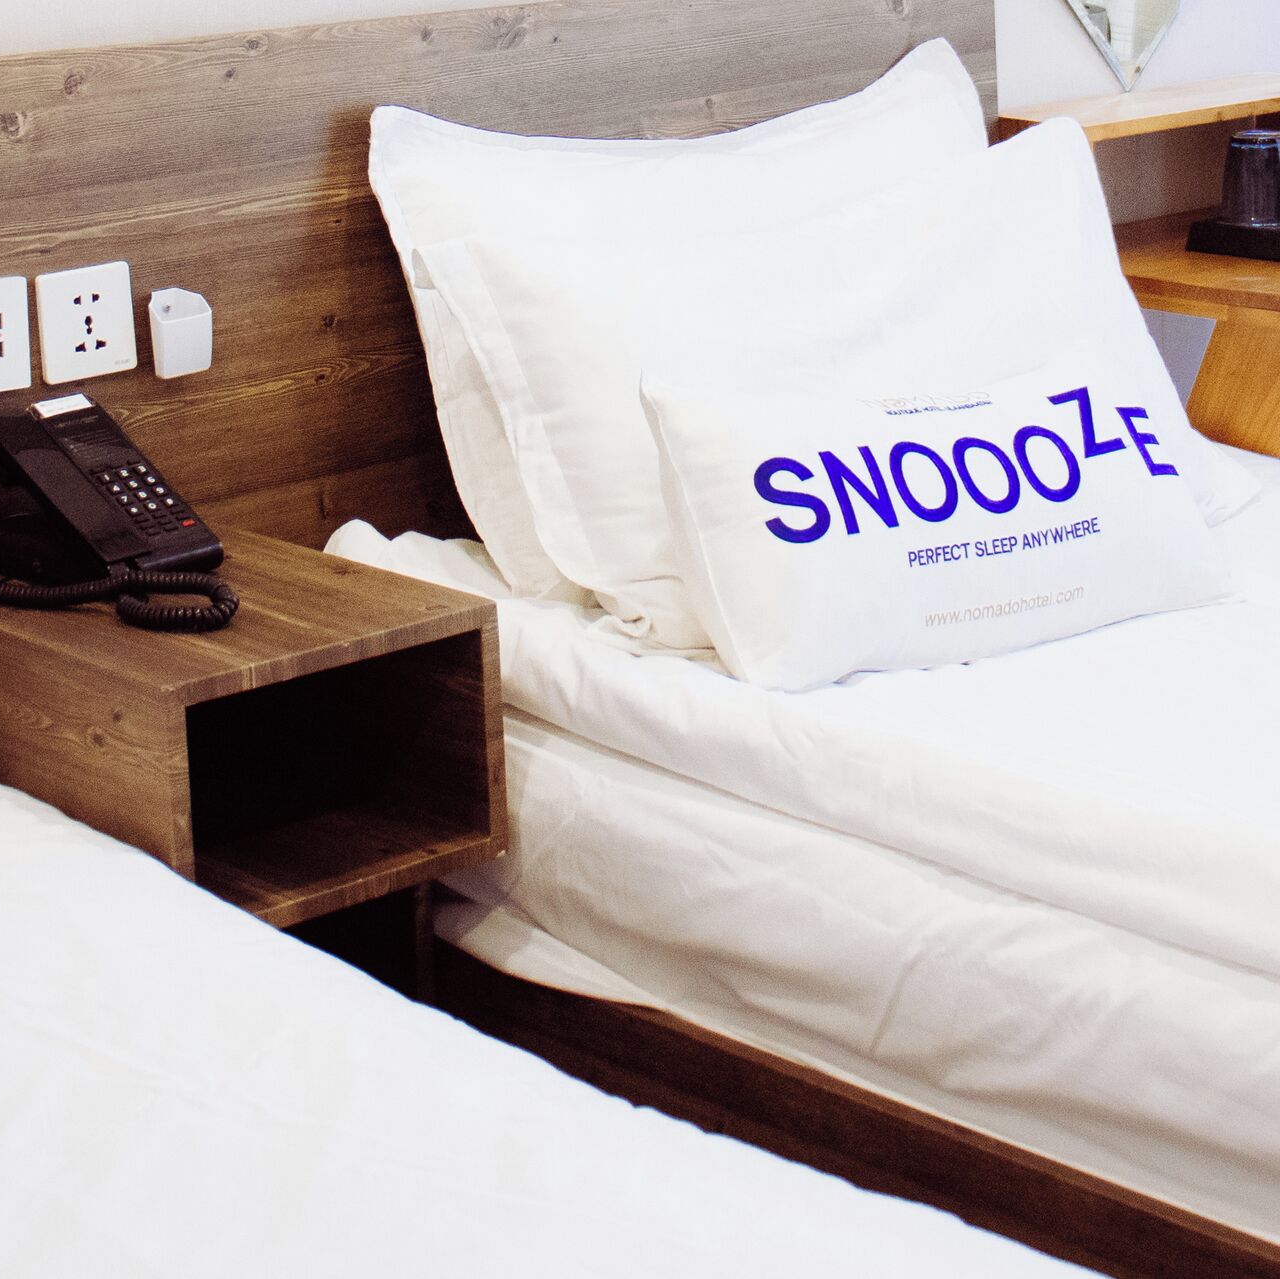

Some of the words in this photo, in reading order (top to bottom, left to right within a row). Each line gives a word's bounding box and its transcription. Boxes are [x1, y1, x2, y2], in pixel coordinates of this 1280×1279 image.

[753, 386, 1180, 544] SNOOOZE
[908, 542, 970, 568] PERFECT
[974, 536, 1018, 558] SLEEP
[1022, 517, 1101, 551] ANYWHERE
[924, 585, 1085, 627] www.nomadohotel.com
